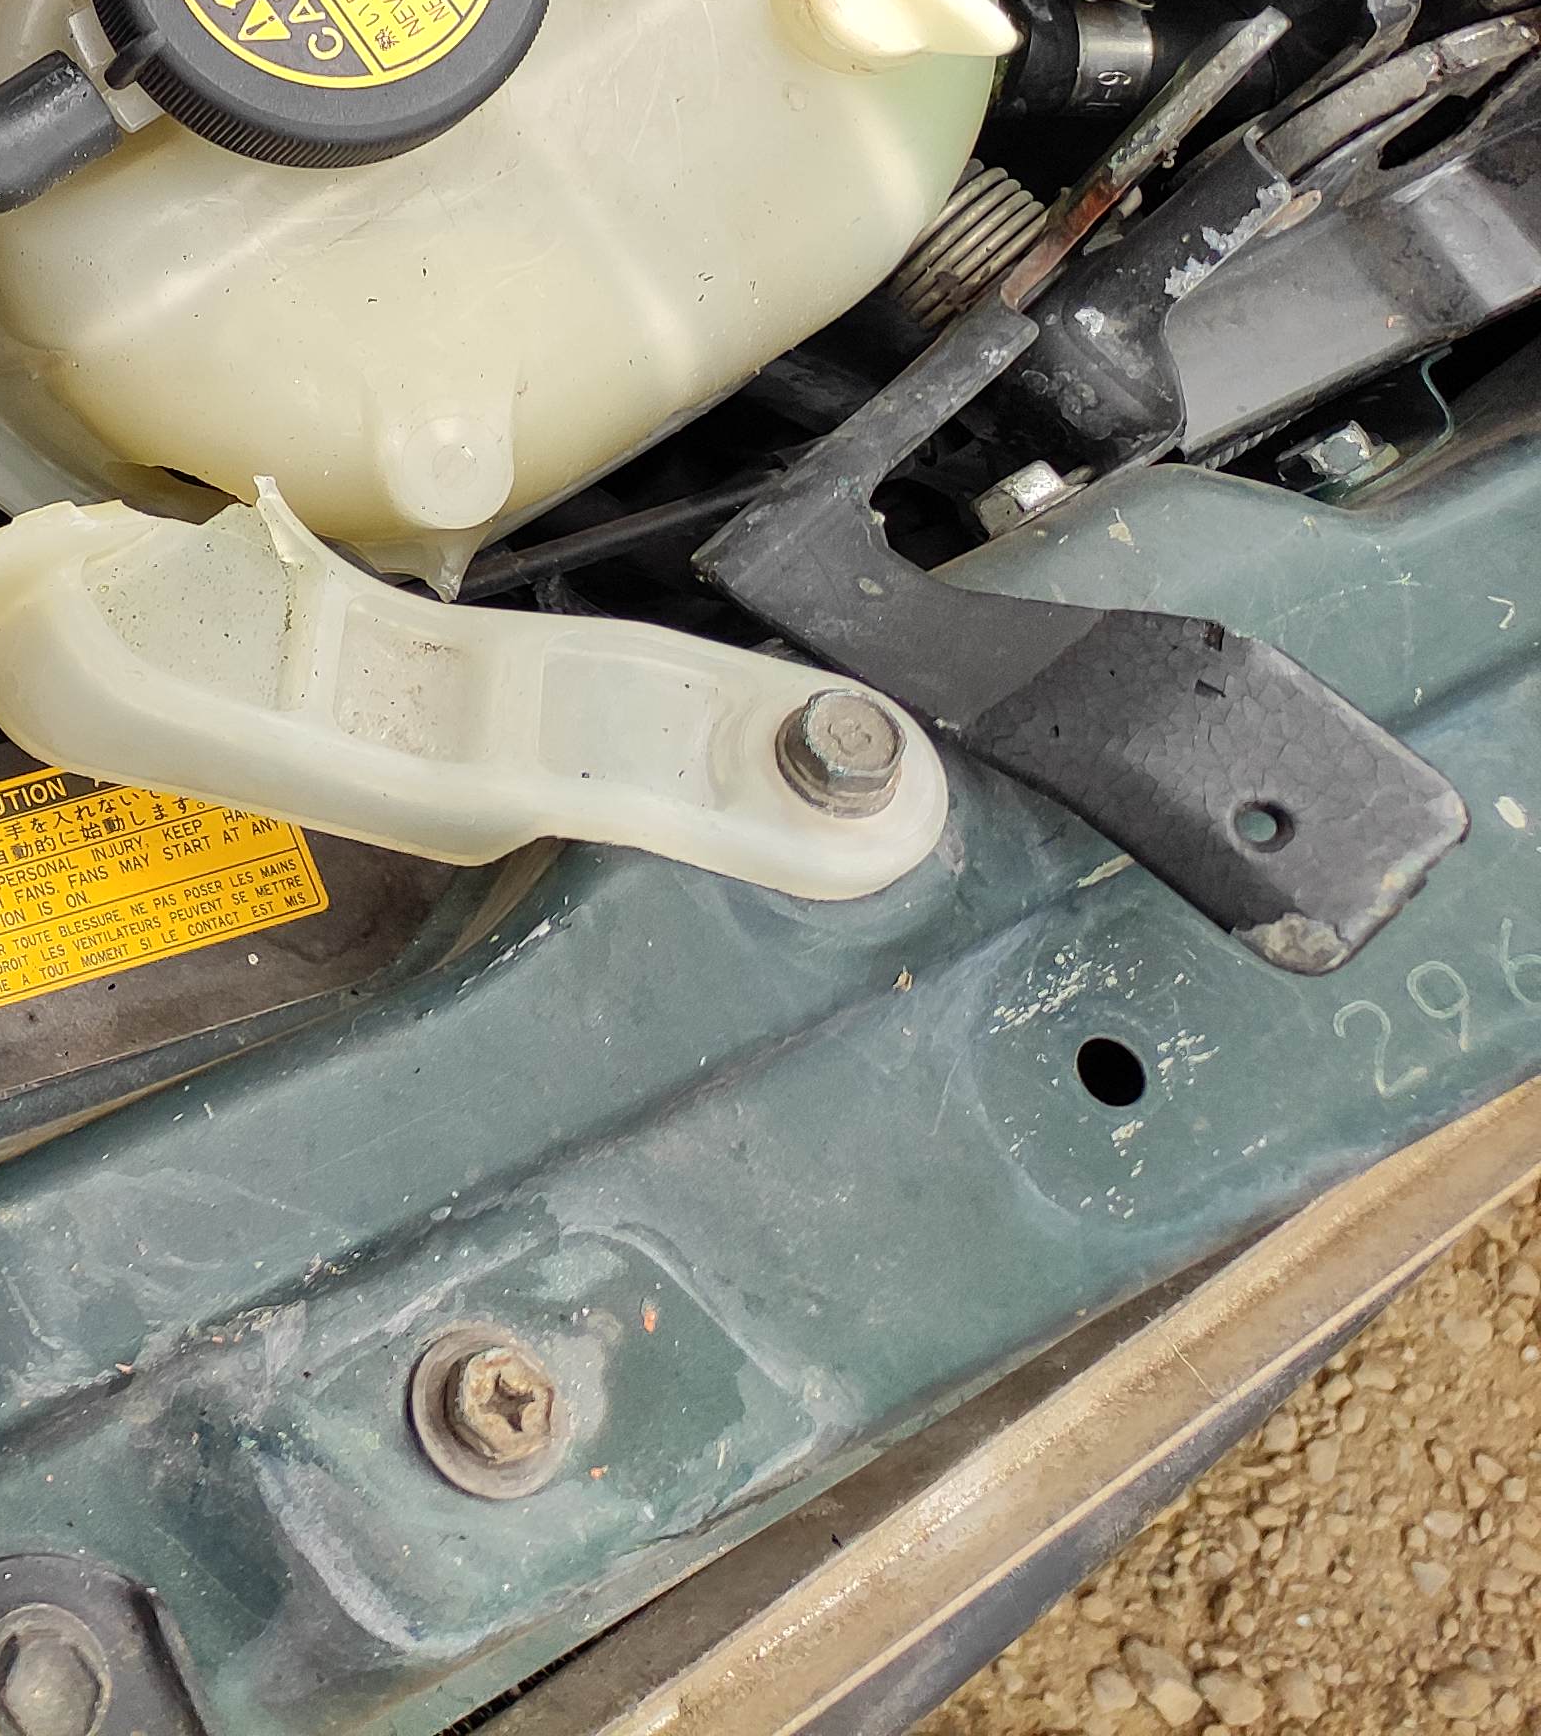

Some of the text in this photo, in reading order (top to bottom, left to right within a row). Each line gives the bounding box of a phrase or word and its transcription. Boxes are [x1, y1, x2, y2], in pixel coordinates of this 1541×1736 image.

[67, 865, 109, 889] FANS
[118, 853, 152, 874] MAY
[162, 835, 213, 861] START
[221, 826, 242, 844] AT
[249, 815, 281, 836] ANY
[161, 818, 204, 843] KEEP
[13, 929, 52, 951] TOUTE
[130, 901, 148, 917] NE
[152, 893, 177, 910] PAS
[183, 879, 223, 901] POSER
[229, 870, 254, 887] LES
[259, 858, 297, 879] MAINS
[37, 900, 53, 917] IS
[39, 960, 71, 980] TOUT
[80, 943, 130, 968] MOMENT
[138, 936, 152, 950] SI
[160, 929, 178, 944] LE
[186, 910, 241, 937] CONTACT
[250, 901, 275, 918] EST
[40, 943, 65, 961] LES
[72, 915, 161, 952] VENTILATEURS
[169, 897, 224, 924] PEUVENT
[230, 890, 248, 905] SE
[254, 874, 303, 899] METTRE
